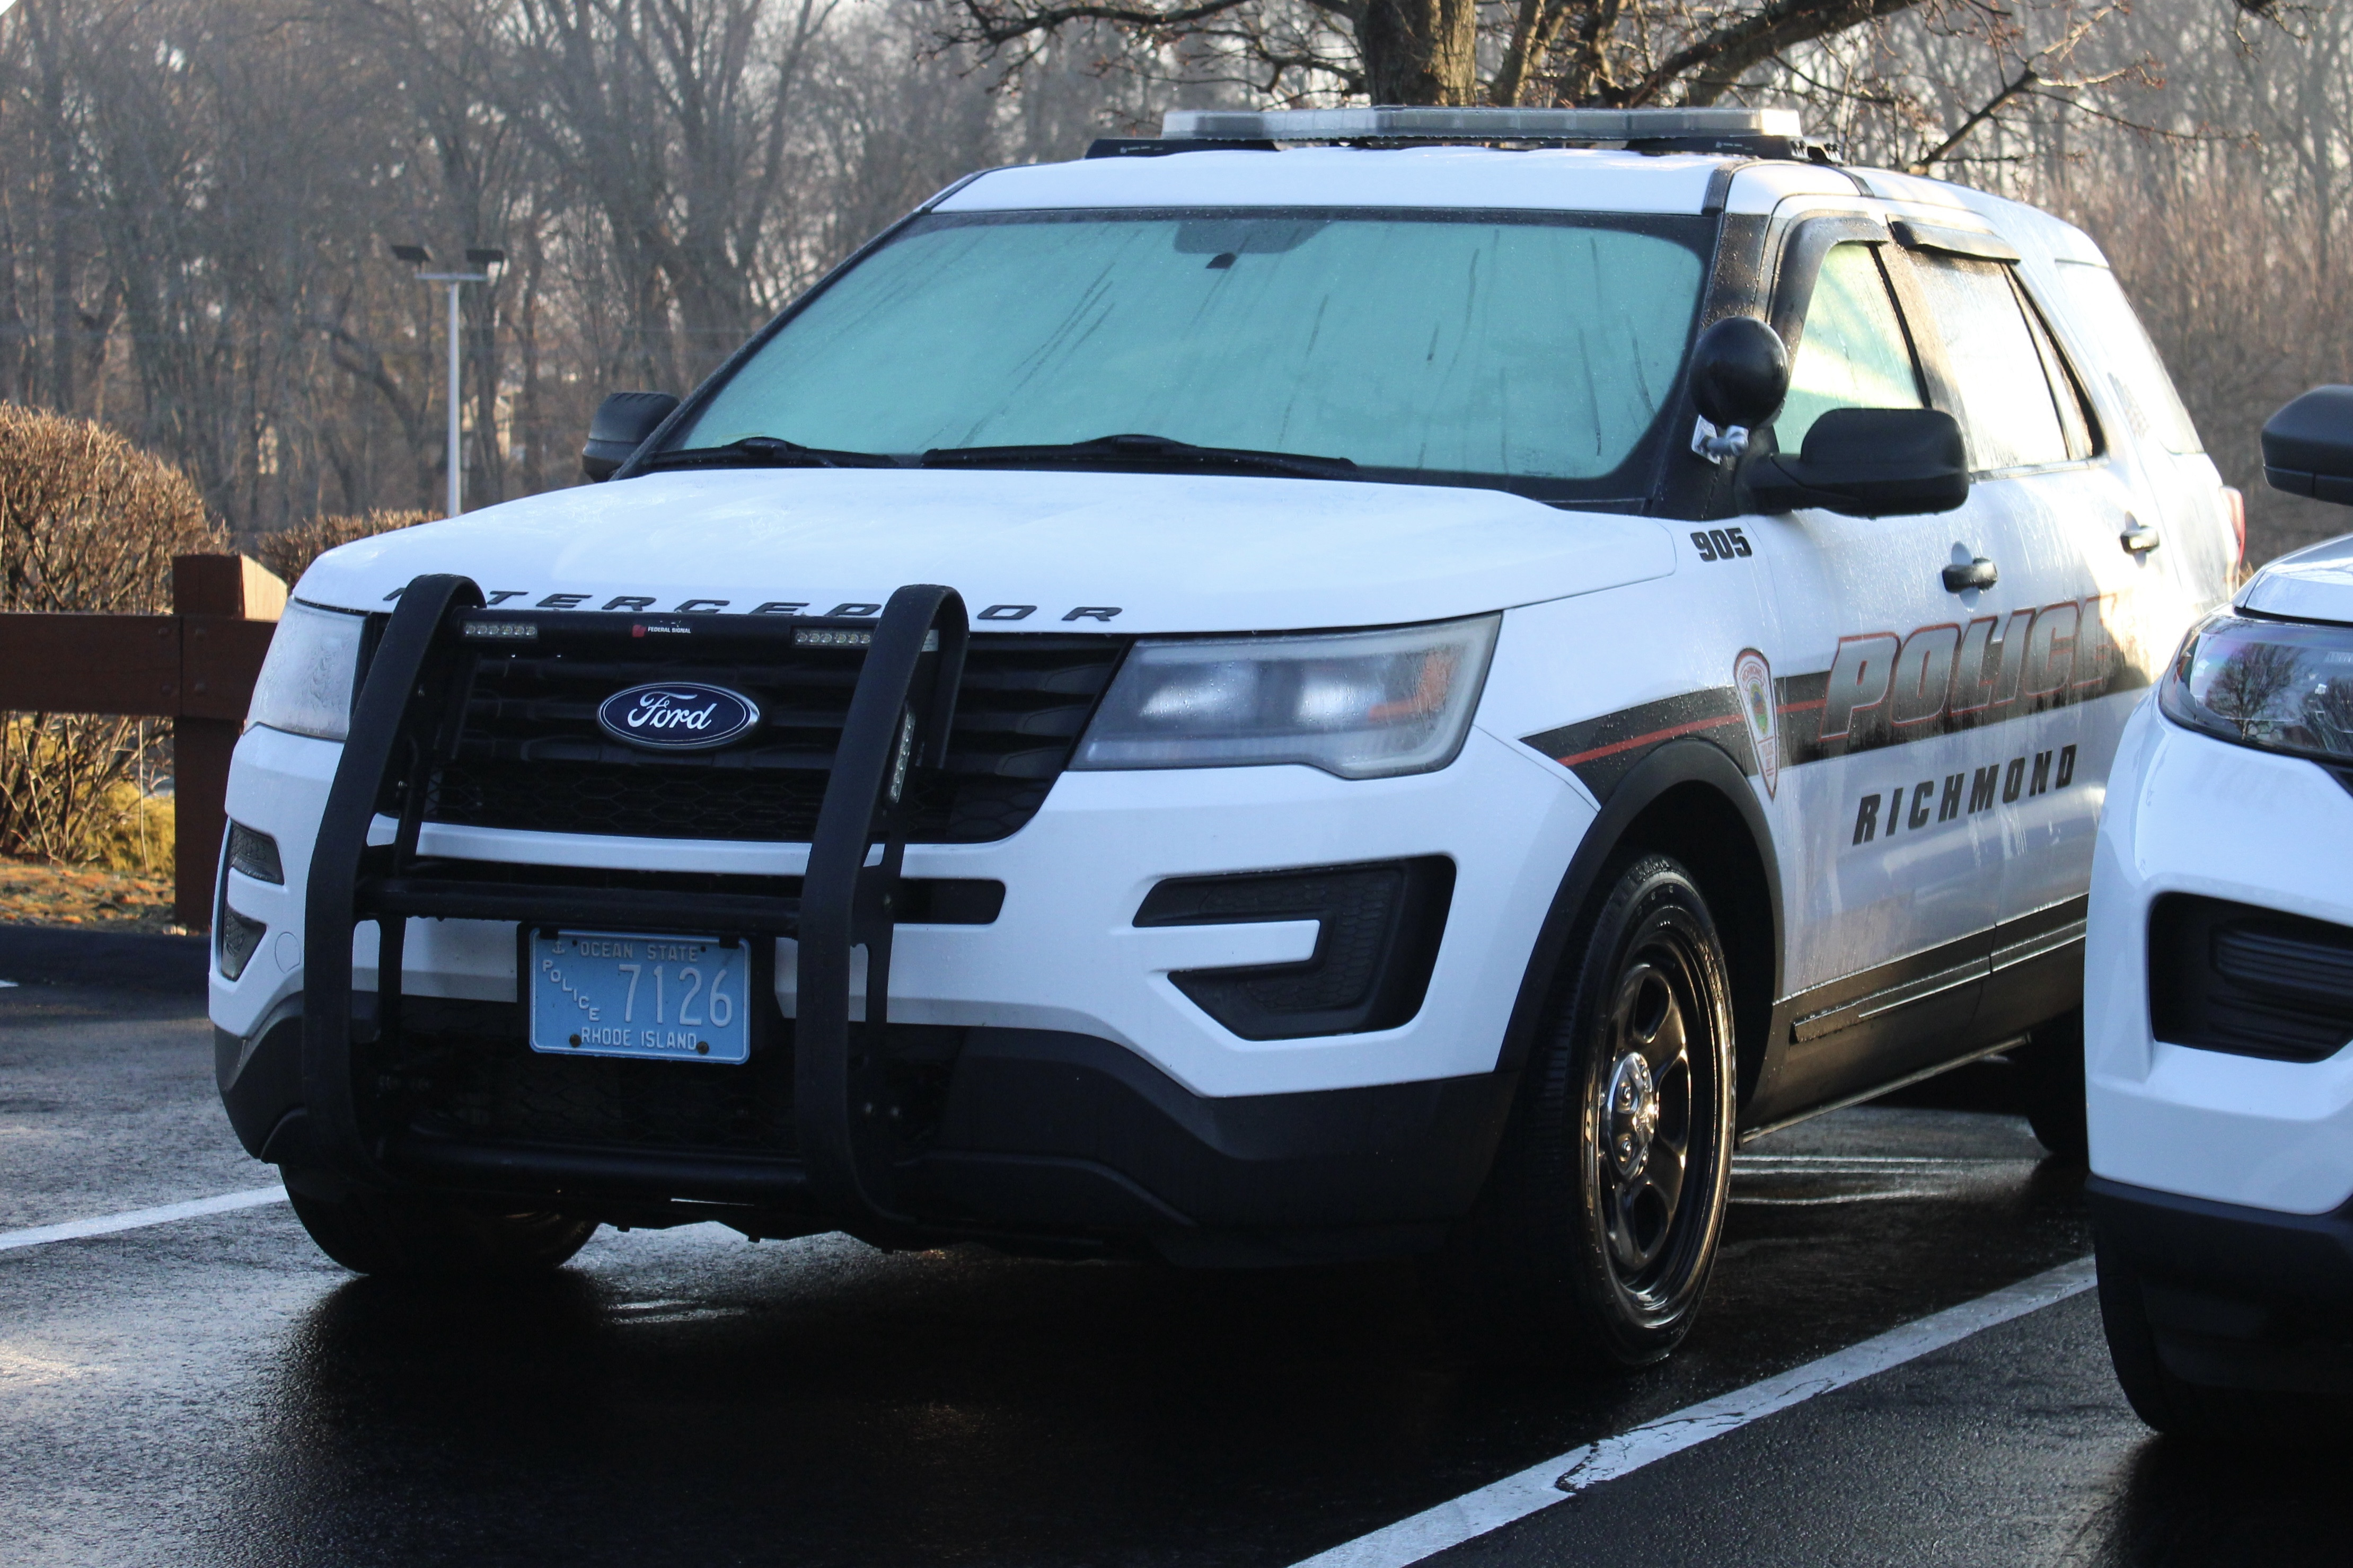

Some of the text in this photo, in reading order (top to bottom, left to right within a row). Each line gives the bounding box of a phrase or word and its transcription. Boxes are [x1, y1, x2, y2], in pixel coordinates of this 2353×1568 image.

[1690, 527, 1752, 562] 905
[383, 587, 1123, 622] ITERCEPOR
[1818, 593, 2119, 742] POLICE
[628, 691, 717, 730] Ford
[1852, 744, 2077, 846] RICHMOND
[580, 942, 698, 962] OCEAN STATE
[542, 960, 600, 1022] POLICE
[618, 963, 733, 1028] 7126
[581, 1027, 698, 1051] RHODE ISLAND
